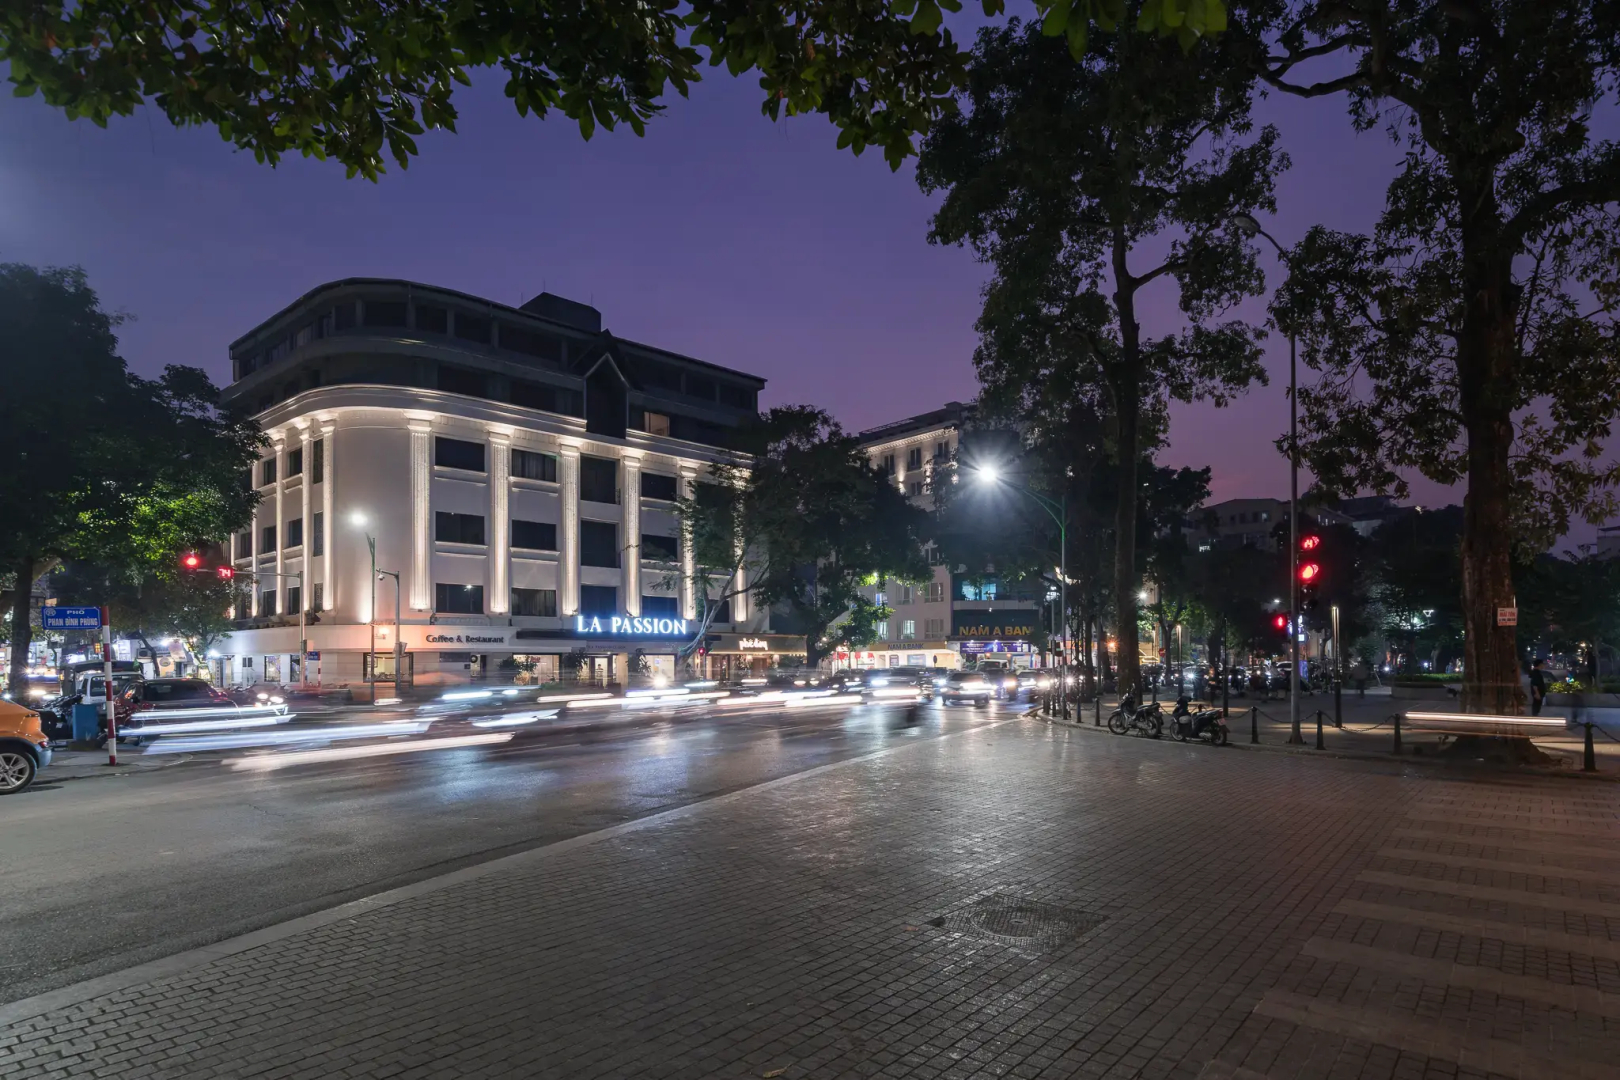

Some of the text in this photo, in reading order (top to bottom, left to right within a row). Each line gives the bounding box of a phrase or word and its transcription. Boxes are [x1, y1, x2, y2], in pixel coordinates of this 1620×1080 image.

[48, 617, 64, 626] PHAN
[577, 615, 687, 634] LA PASSION
[960, 626, 1035, 636] NAM A BAN
[426, 635, 504, 643] Coffee & Restaurant
